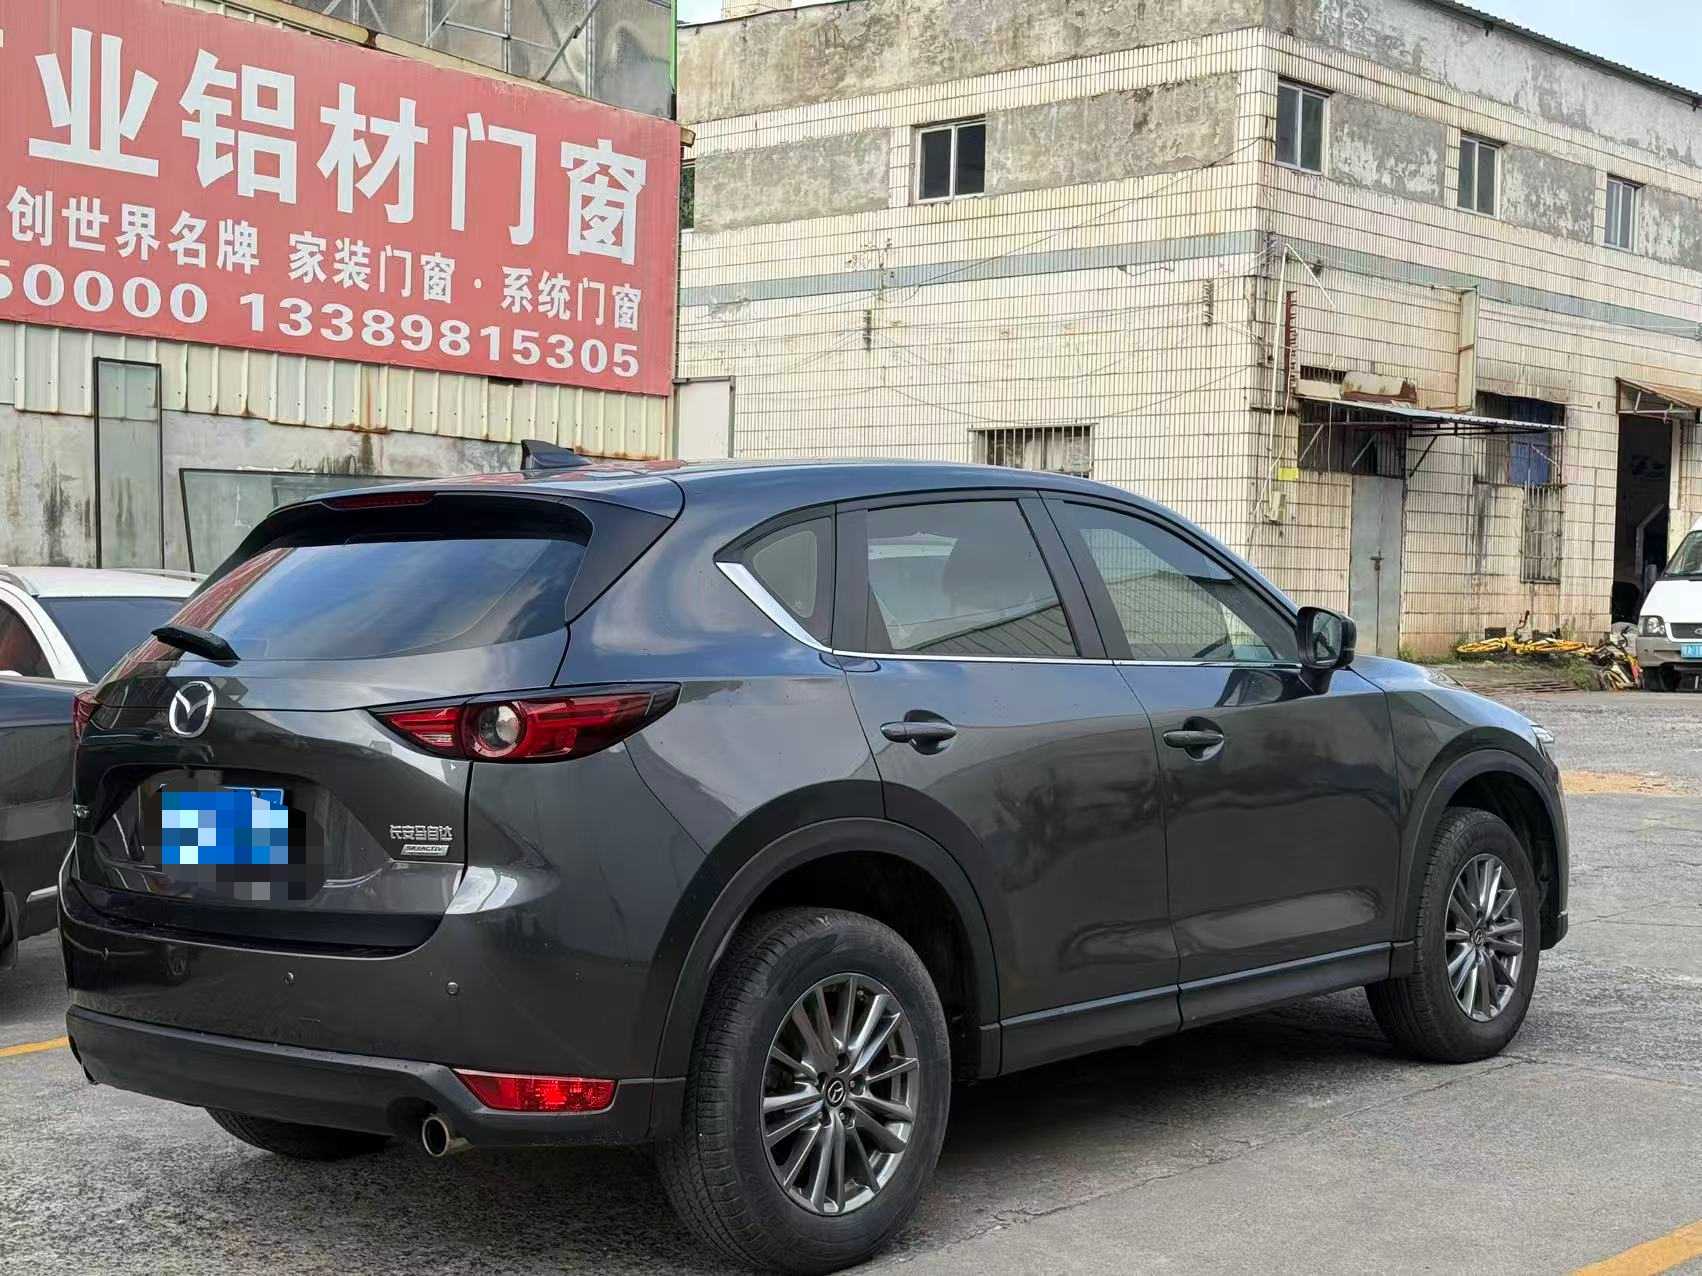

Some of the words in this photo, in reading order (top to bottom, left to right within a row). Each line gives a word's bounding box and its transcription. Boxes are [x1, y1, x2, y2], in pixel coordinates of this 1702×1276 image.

[0, 27, 647, 265] 业铝材门窗
[6, 185, 260, 274] 创世界名牌
[239, 292, 641, 378] 13389815305
[389, 824, 453, 842] 长安马自达
